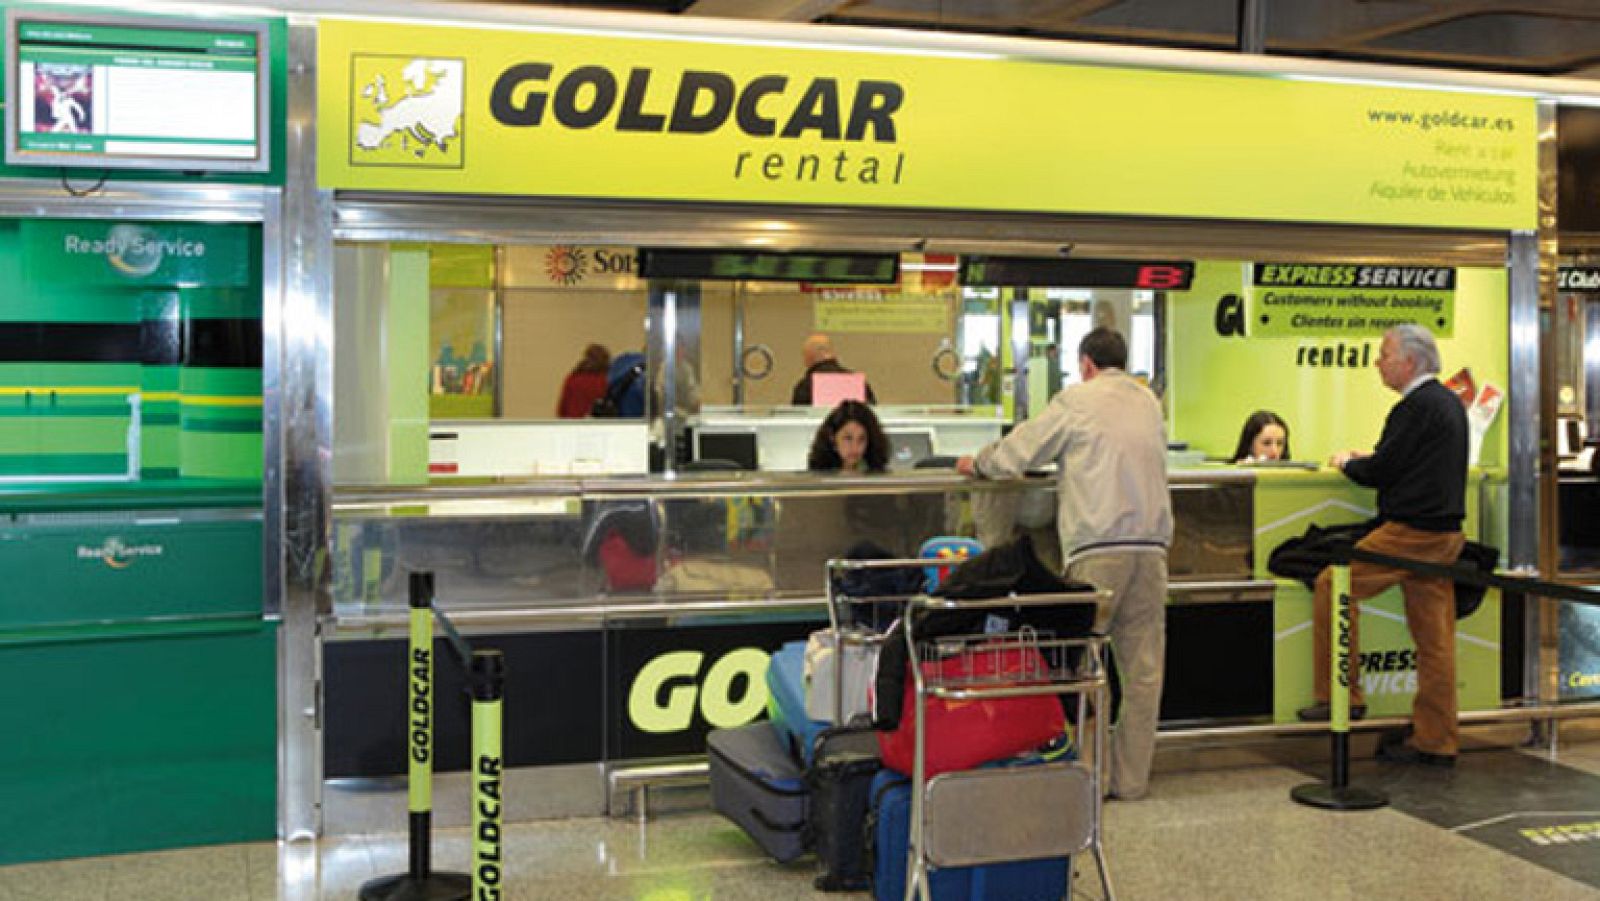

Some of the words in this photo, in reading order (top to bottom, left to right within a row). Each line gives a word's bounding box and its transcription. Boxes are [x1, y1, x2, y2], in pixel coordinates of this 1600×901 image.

[489, 61, 906, 143] GOLDCAR
[1368, 109, 1515, 131] www.goldcar.es
[734, 149, 905, 184] rental
[1260, 263, 1357, 284] EXPRESS
[1357, 267, 1451, 288] SERVICE
[1263, 291, 1334, 307] Customers
[1337, 294, 1389, 309] without
[1391, 295, 1444, 312] booking
[1290, 314, 1344, 328] Clientes
[1347, 316, 1366, 329] sin
[1296, 342, 1371, 368] rental
[412, 647, 431, 764] GOLDCAR
[478, 754, 502, 901] GOLDCAR
